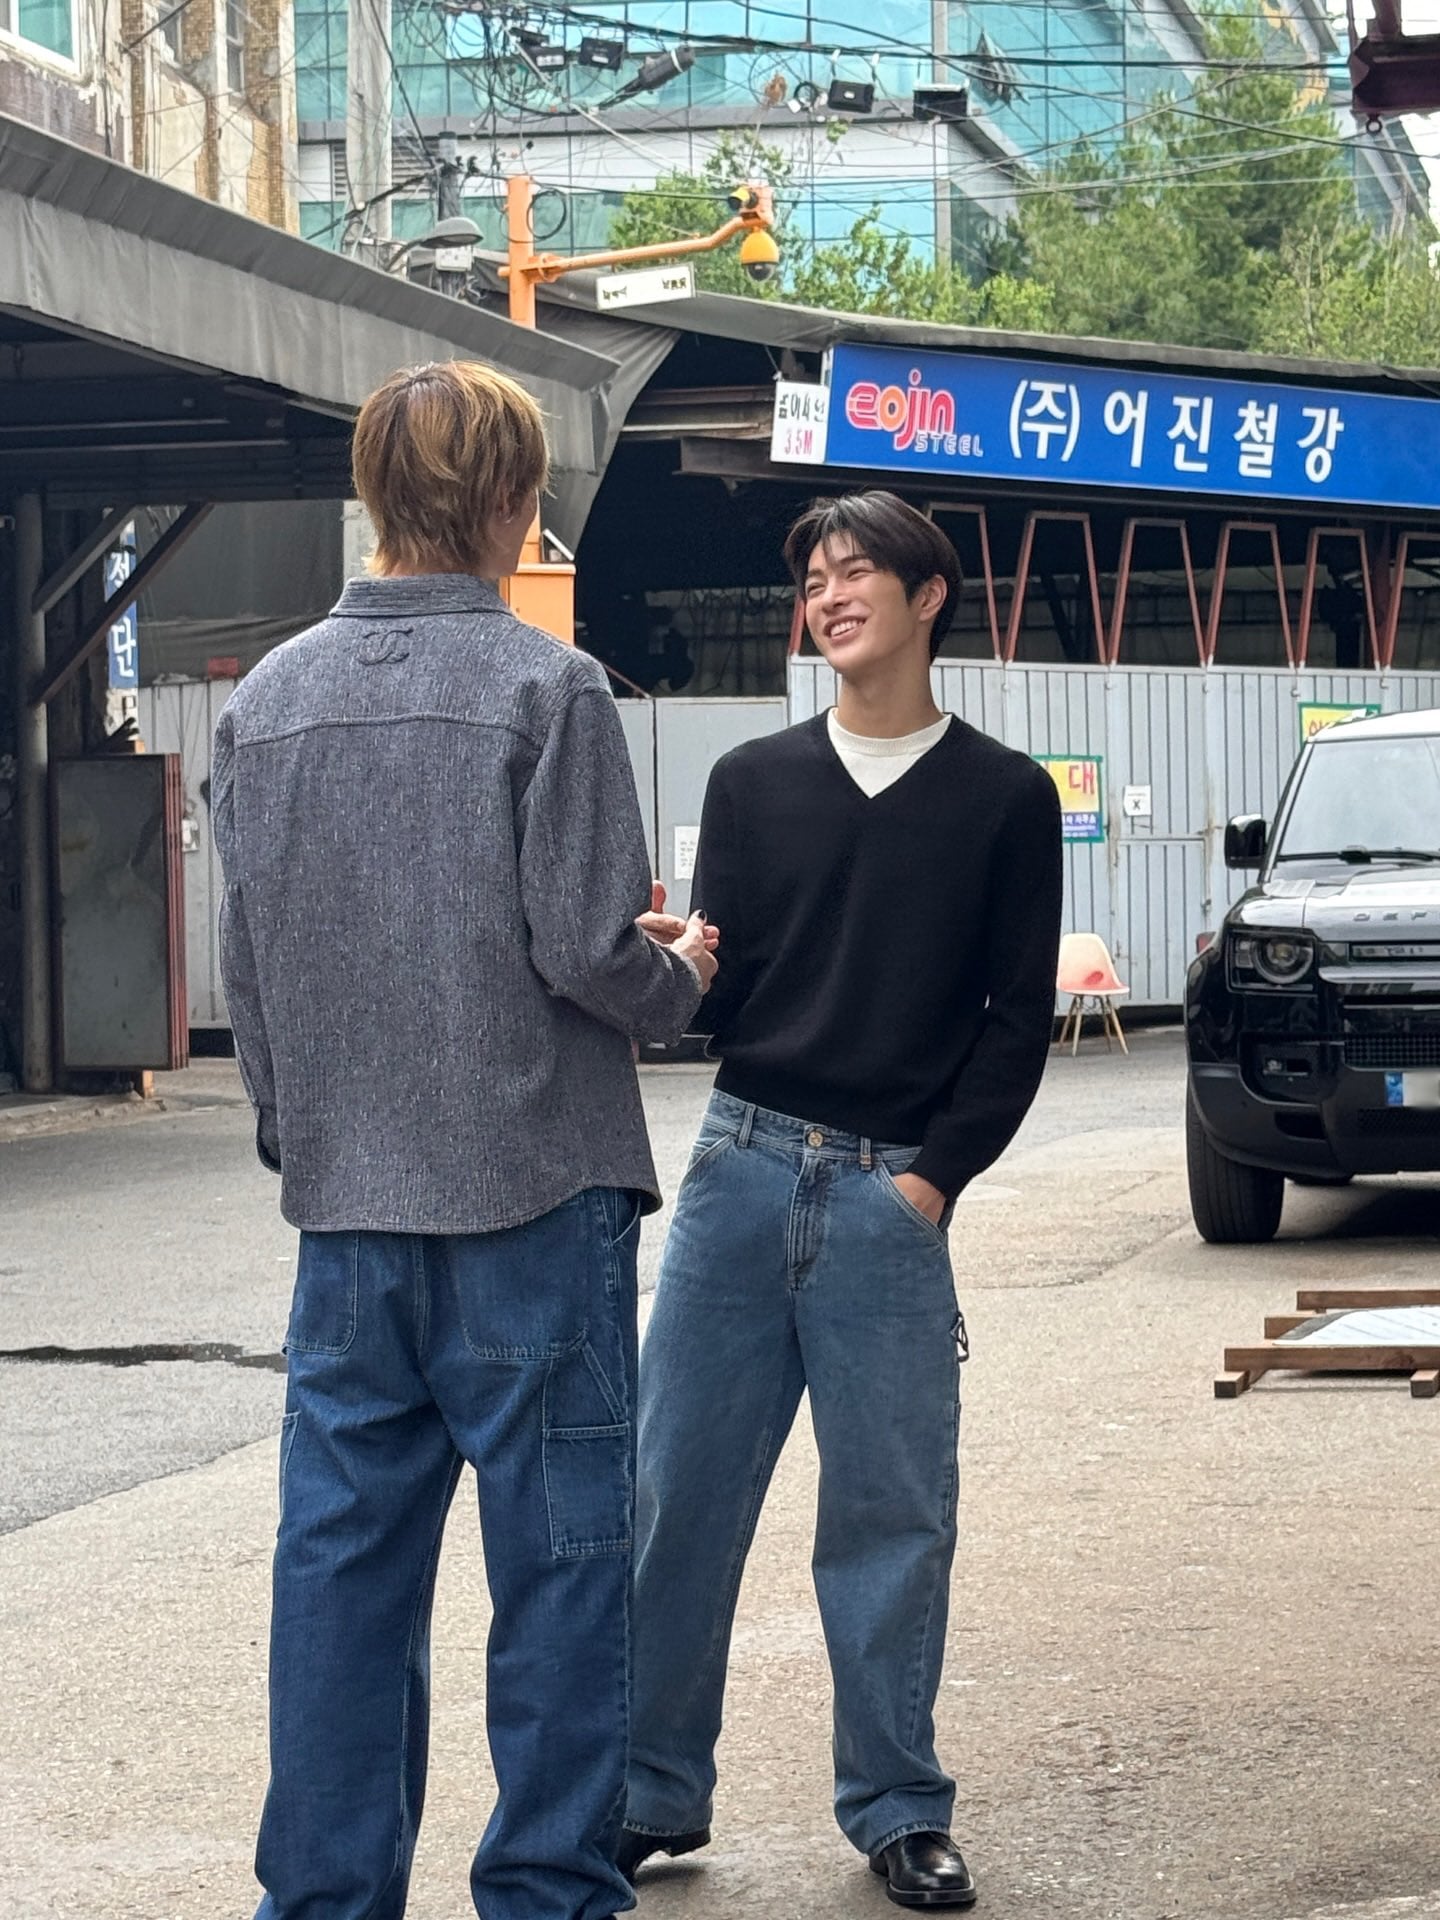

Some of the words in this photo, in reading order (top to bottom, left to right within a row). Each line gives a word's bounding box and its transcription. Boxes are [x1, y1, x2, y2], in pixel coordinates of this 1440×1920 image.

[845, 368, 956, 452] eojin
[914, 429, 984, 458] STEEL
[1009, 379, 1081, 463] (주)
[1103, 389, 1345, 484] 어진철강
